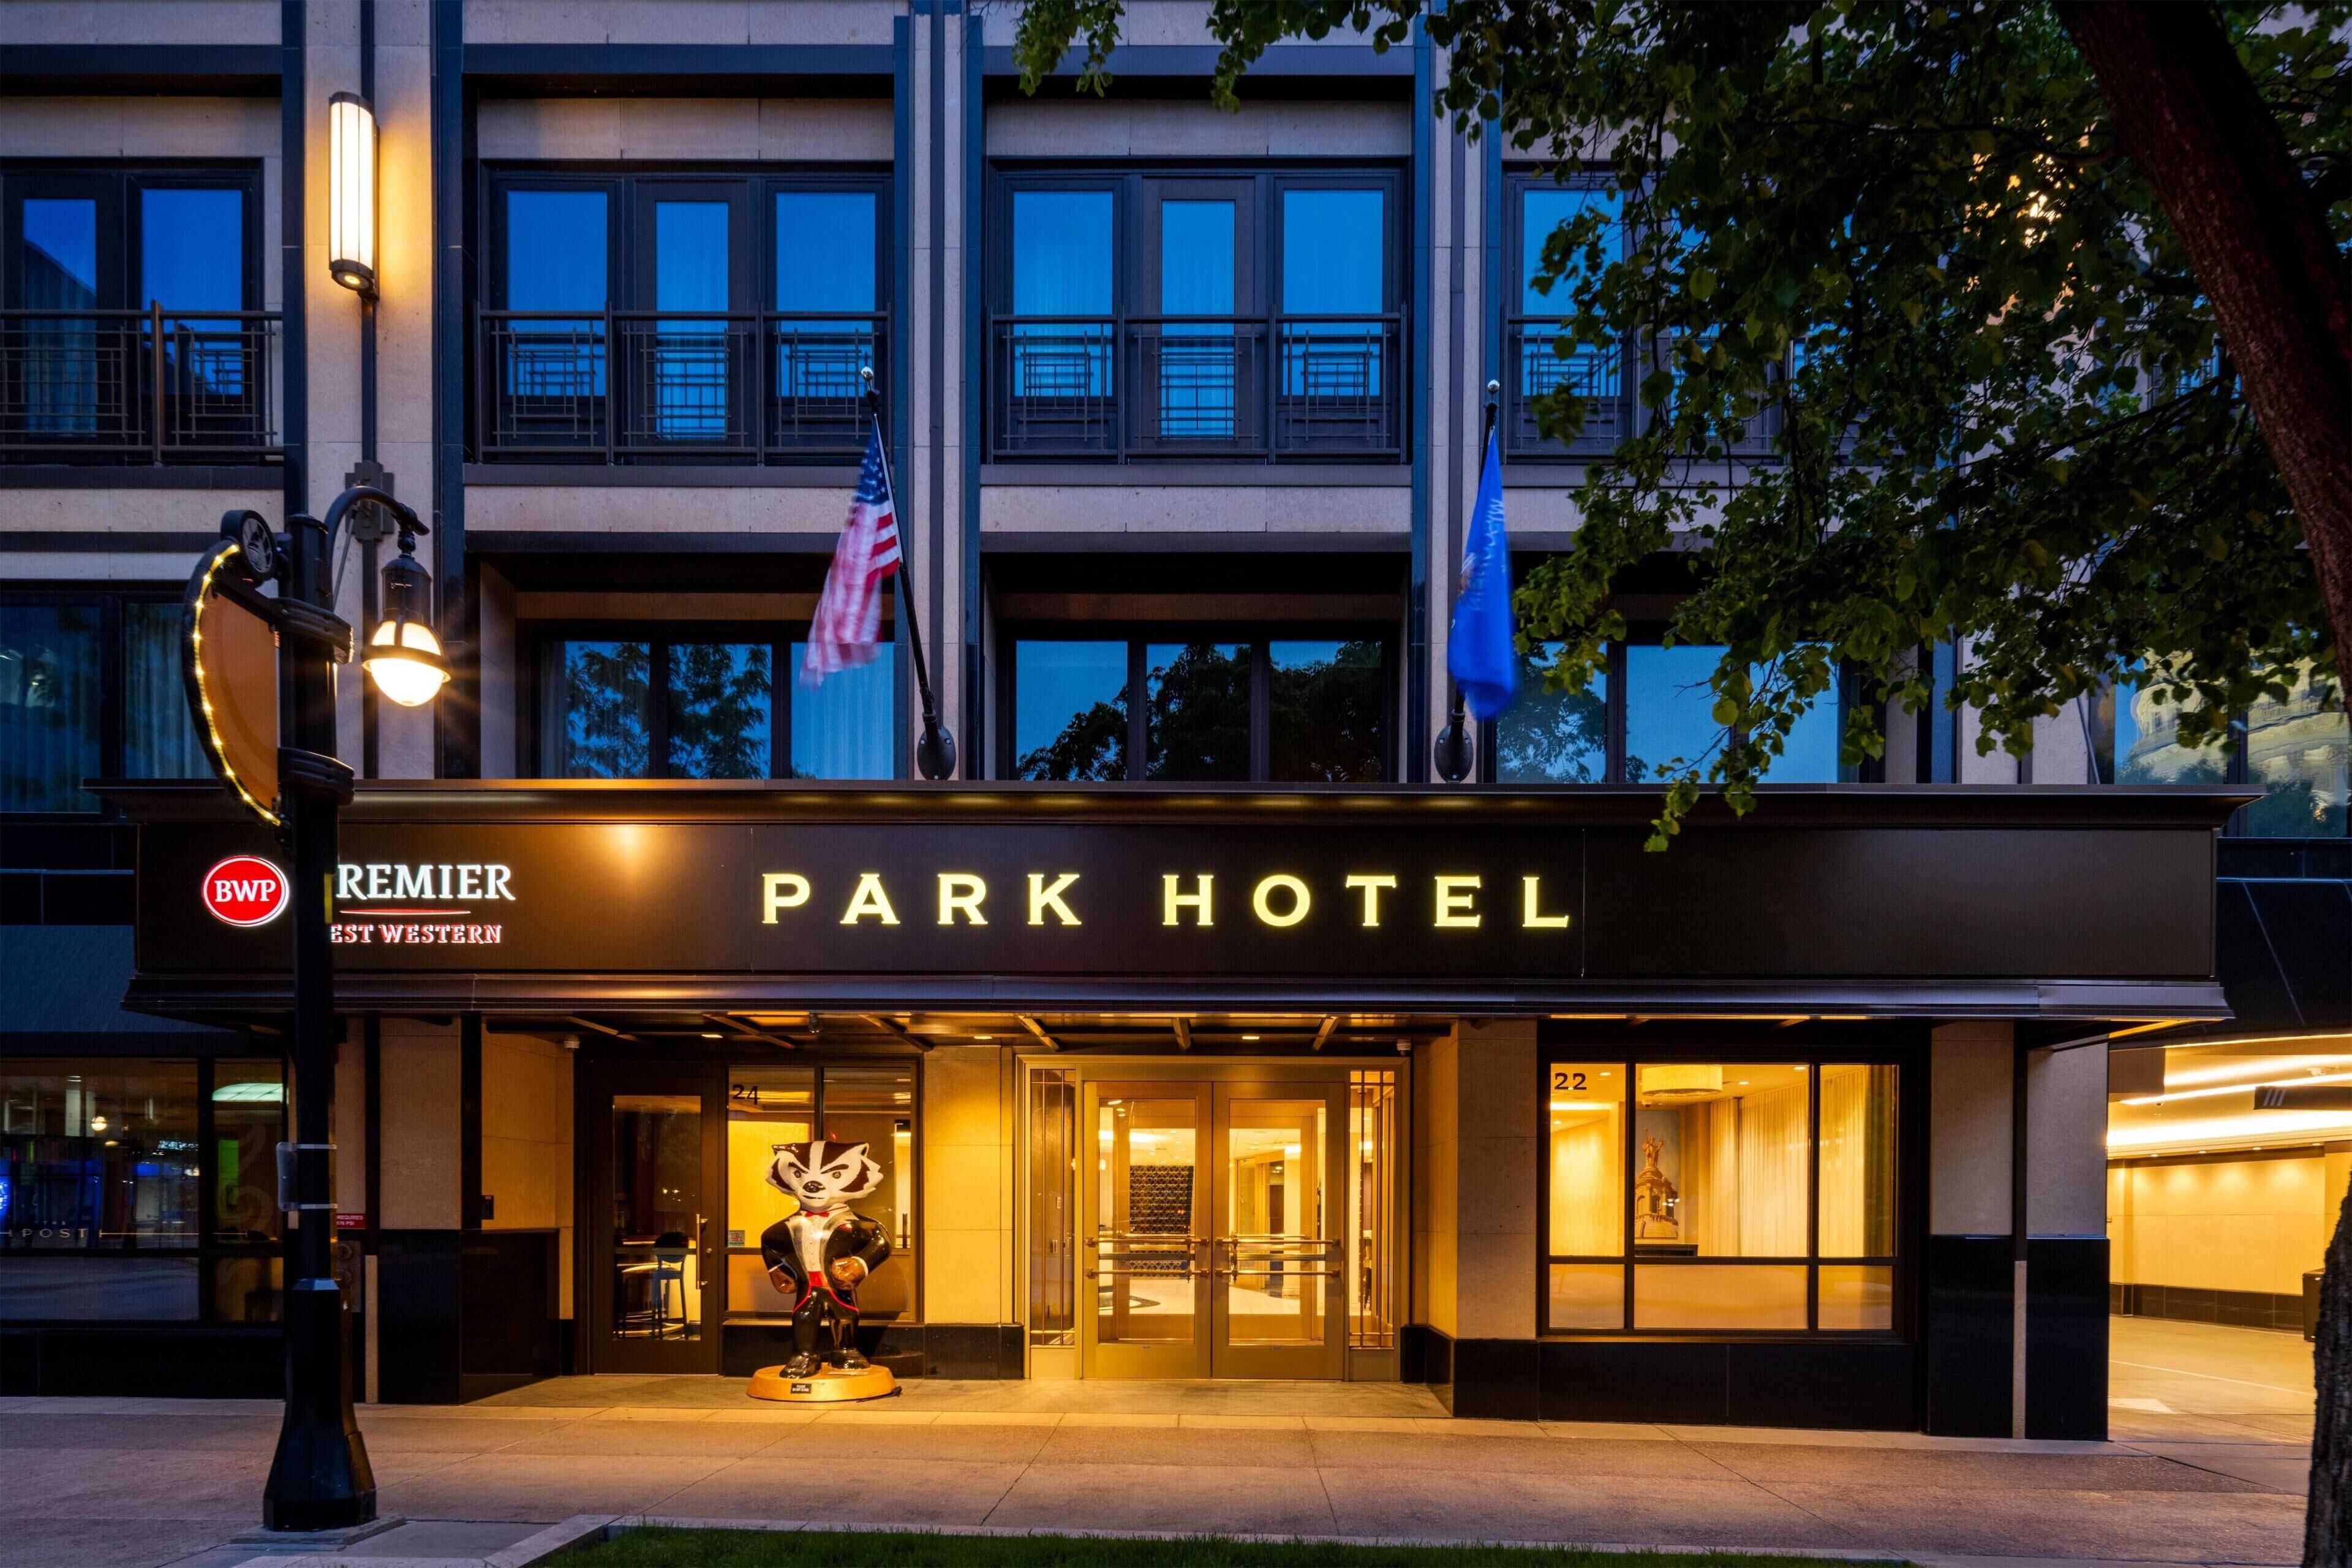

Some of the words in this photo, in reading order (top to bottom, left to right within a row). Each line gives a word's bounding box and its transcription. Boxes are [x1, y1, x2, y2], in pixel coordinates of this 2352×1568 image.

[214, 879, 276, 902] BWP
[336, 864, 516, 900] REMIER
[762, 873, 1082, 925] PARK
[1163, 875, 1569, 927] HOTEL
[331, 924, 374, 943] EST
[378, 924, 502, 944] WESTERN
[1555, 1072, 1587, 1090] 22
[733, 1084, 761, 1105] 24
[22, 1228, 87, 1238] POST
